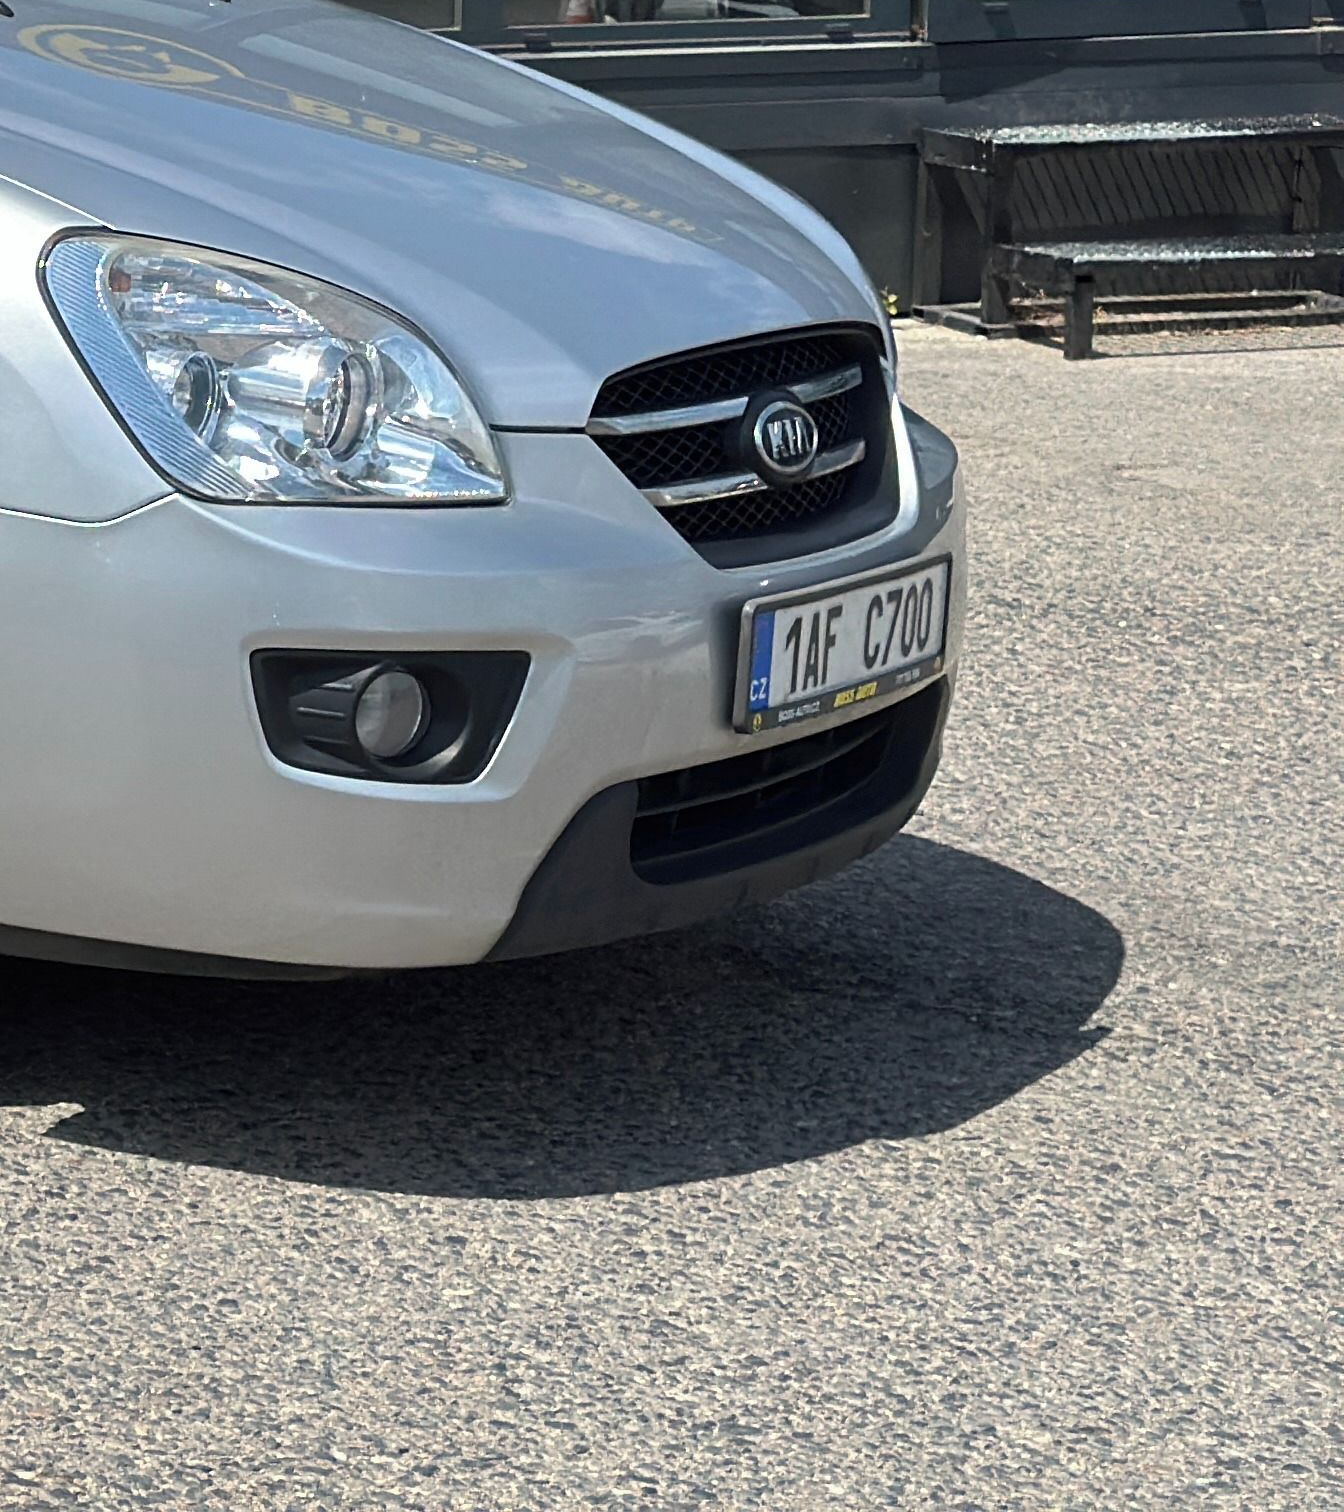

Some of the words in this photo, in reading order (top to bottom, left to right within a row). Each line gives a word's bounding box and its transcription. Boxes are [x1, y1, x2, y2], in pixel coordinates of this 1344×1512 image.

[783, 602, 844, 694] 1AF
[863, 577, 934, 670] C700
[750, 677, 768, 702] CZ
